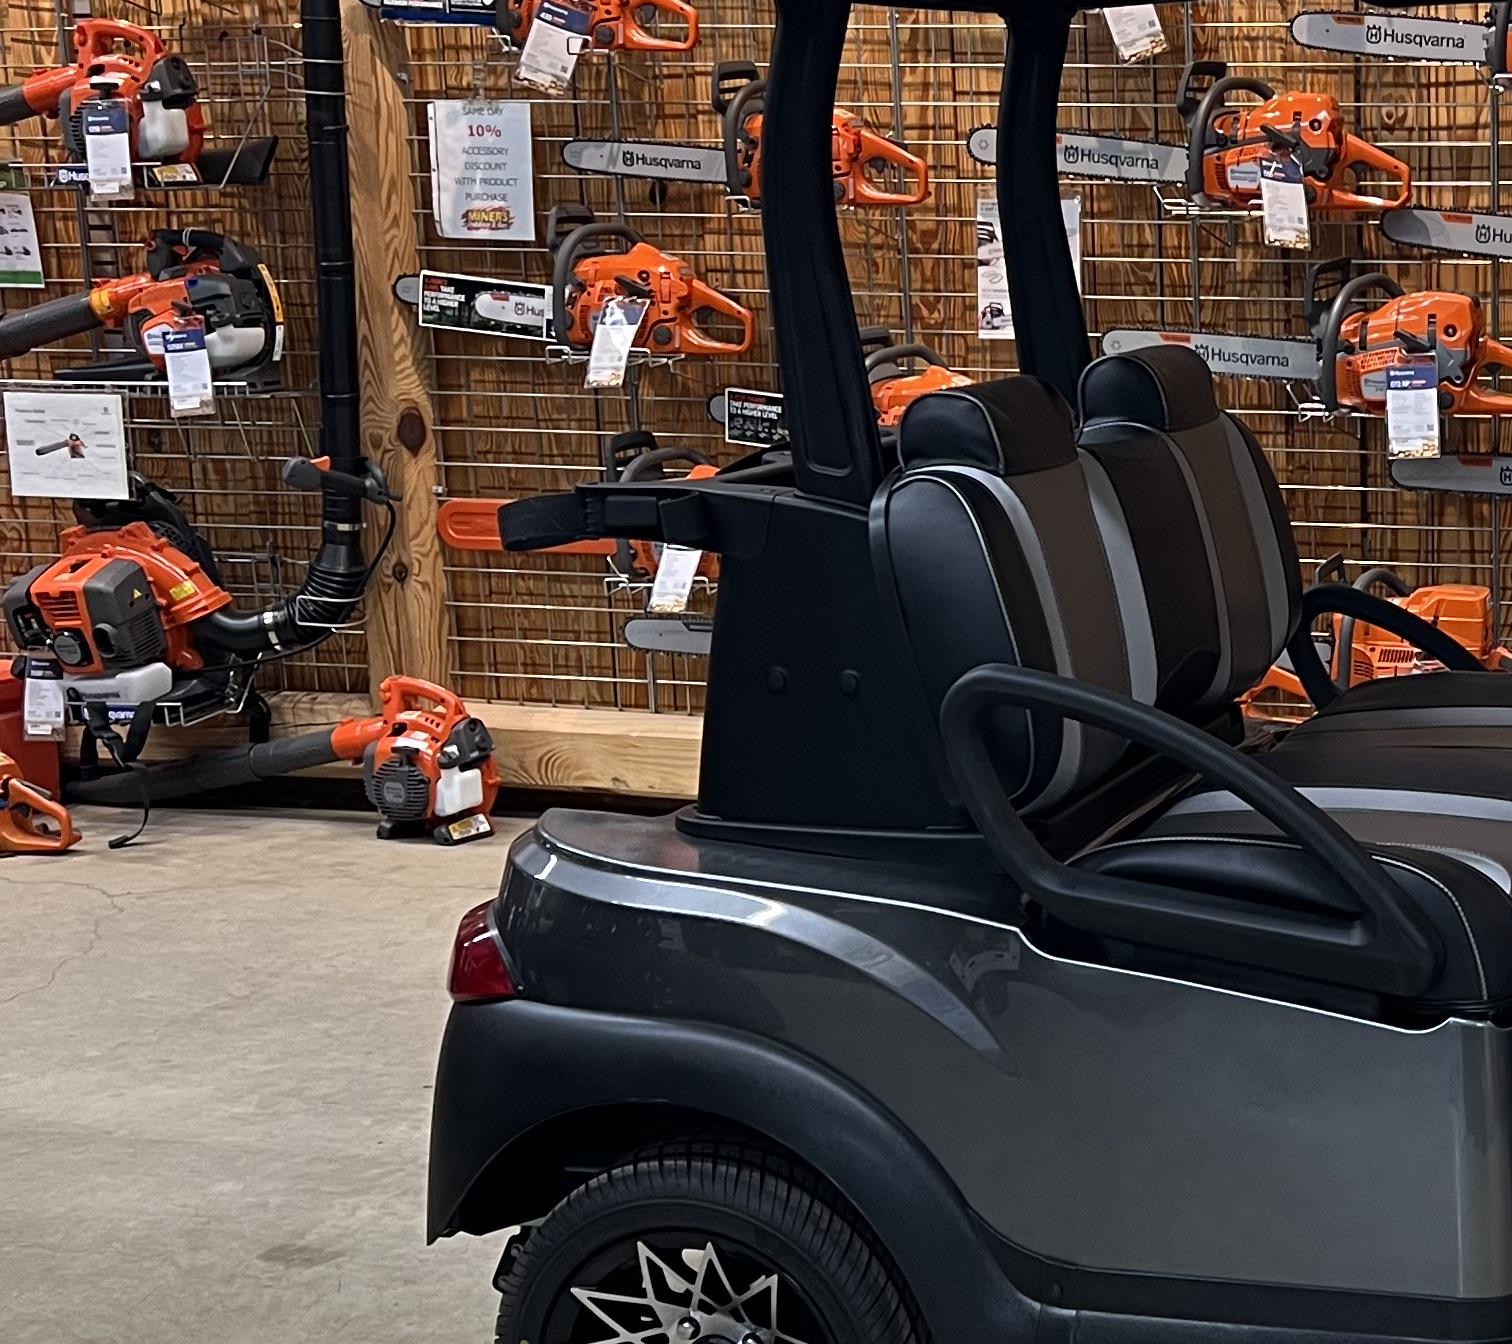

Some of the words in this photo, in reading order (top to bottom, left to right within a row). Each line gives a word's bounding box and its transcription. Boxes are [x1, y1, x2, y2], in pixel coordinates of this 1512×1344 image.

[1383, 28, 1466, 53] Husqvarna
[462, 106, 486, 116] SAME
[487, 106, 505, 116] DAY
[467, 124, 502, 138] 10%
[461, 145, 510, 156] ACCESSORY
[635, 153, 702, 172] Husqvarna
[1080, 146, 1160, 173] Husqvarna
[464, 161, 508, 172] DISCOUNT
[453, 177, 477, 187] WITH
[479, 177, 519, 187] PRODUCT
[465, 192, 509, 202] PURCHASE
[1209, 343, 1291, 370] Husqvarna
